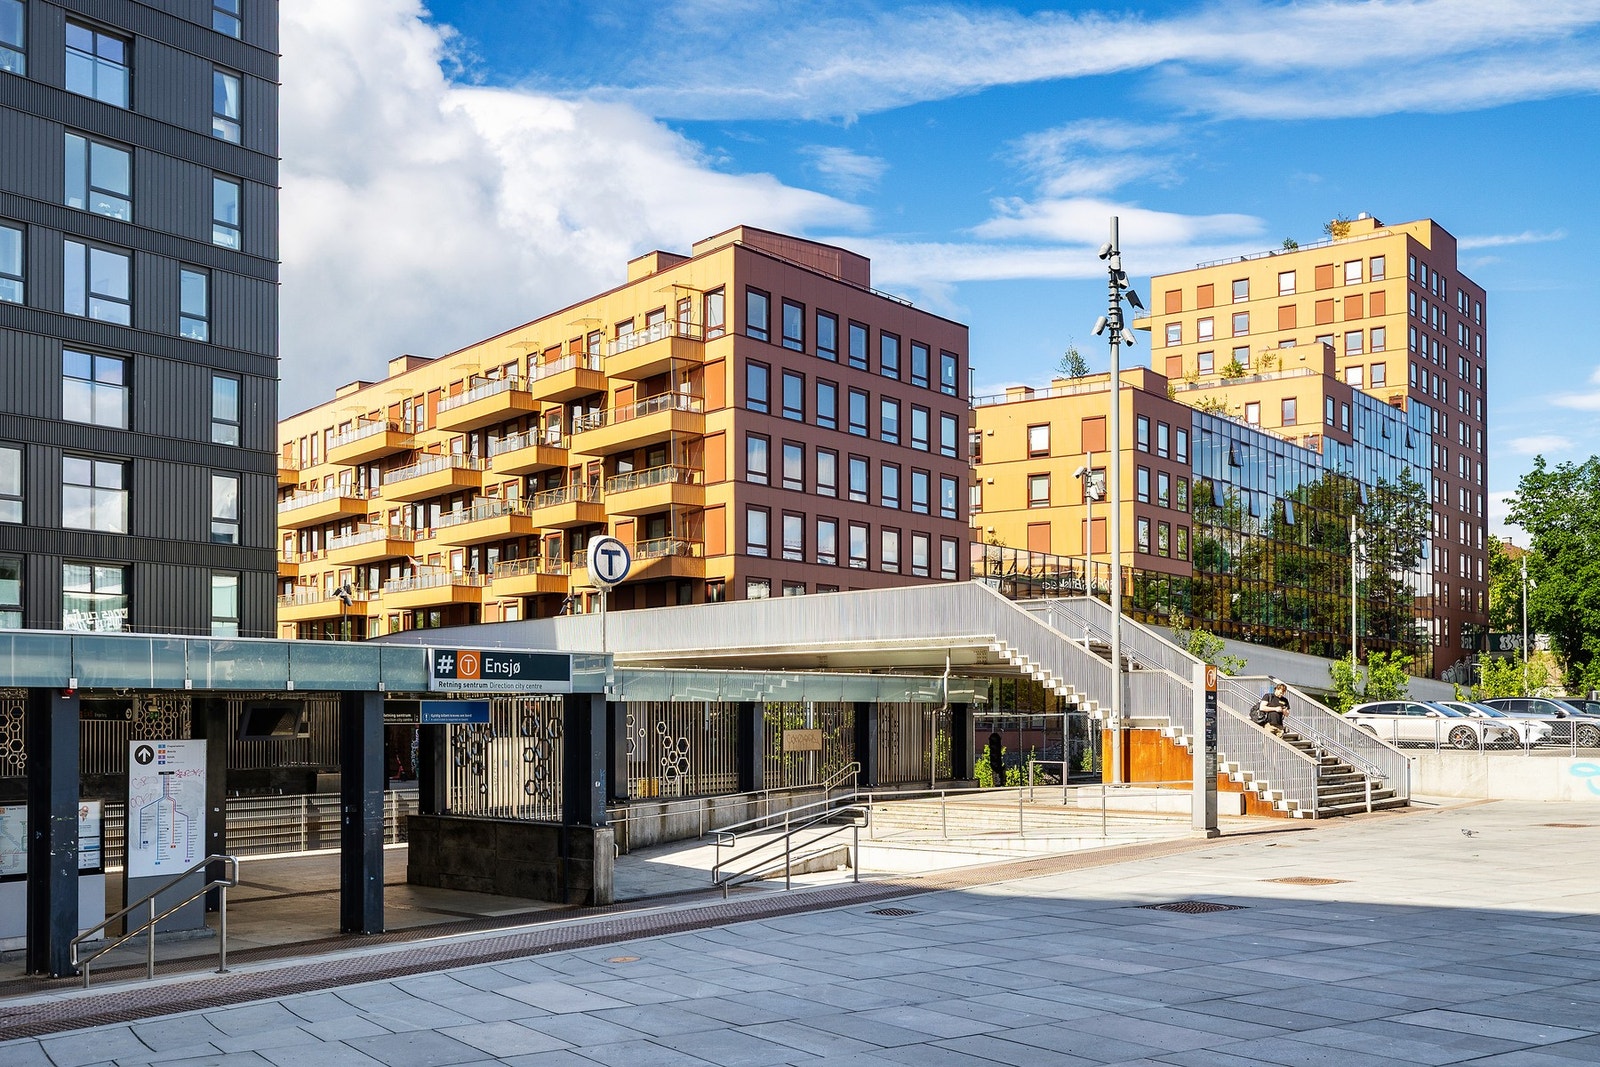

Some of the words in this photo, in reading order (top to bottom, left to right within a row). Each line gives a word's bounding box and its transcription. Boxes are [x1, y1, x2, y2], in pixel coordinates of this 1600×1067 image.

[600, 548, 621, 576] T
[485, 657, 521, 678] Ensjø
[438, 680, 462, 690] Retning
[462, 681, 489, 689] sentrum
[489, 681, 515, 690] Direction
[515, 683, 526, 691] city
